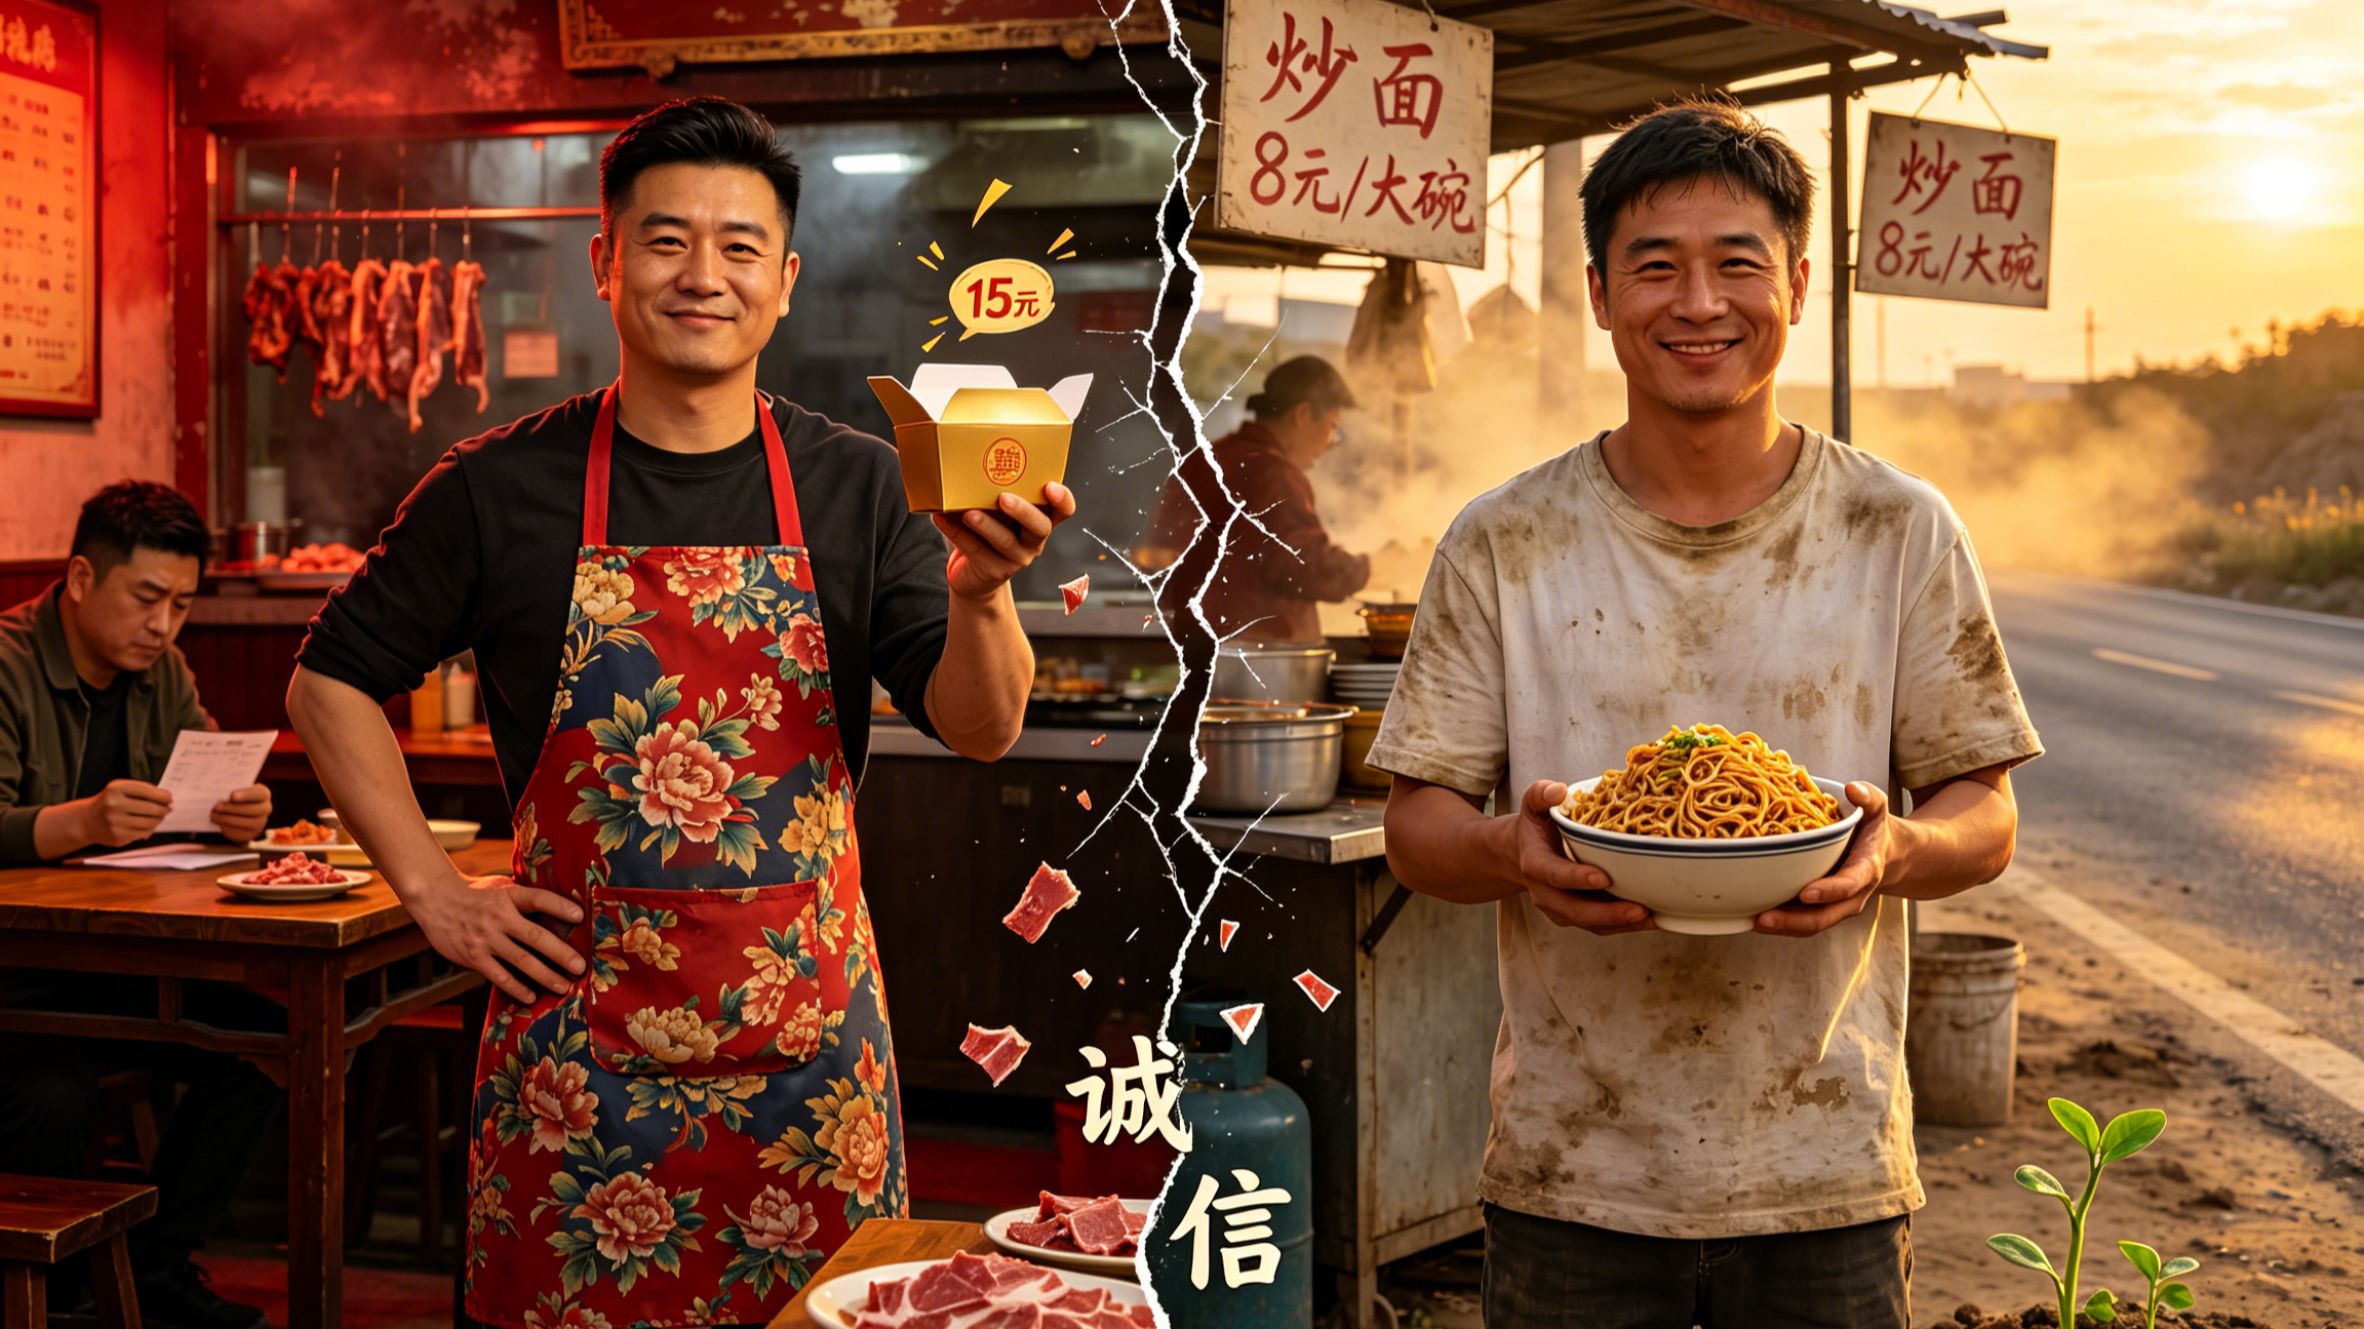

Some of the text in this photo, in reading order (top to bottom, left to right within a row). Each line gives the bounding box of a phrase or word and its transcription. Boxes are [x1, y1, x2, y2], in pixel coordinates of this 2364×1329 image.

[1259, 11, 1444, 140] 炒面
[1250, 130, 1476, 234] 8元/大碗
[1891, 138, 2023, 222] 炒面
[1875, 220, 2043, 292] 8元/大碗
